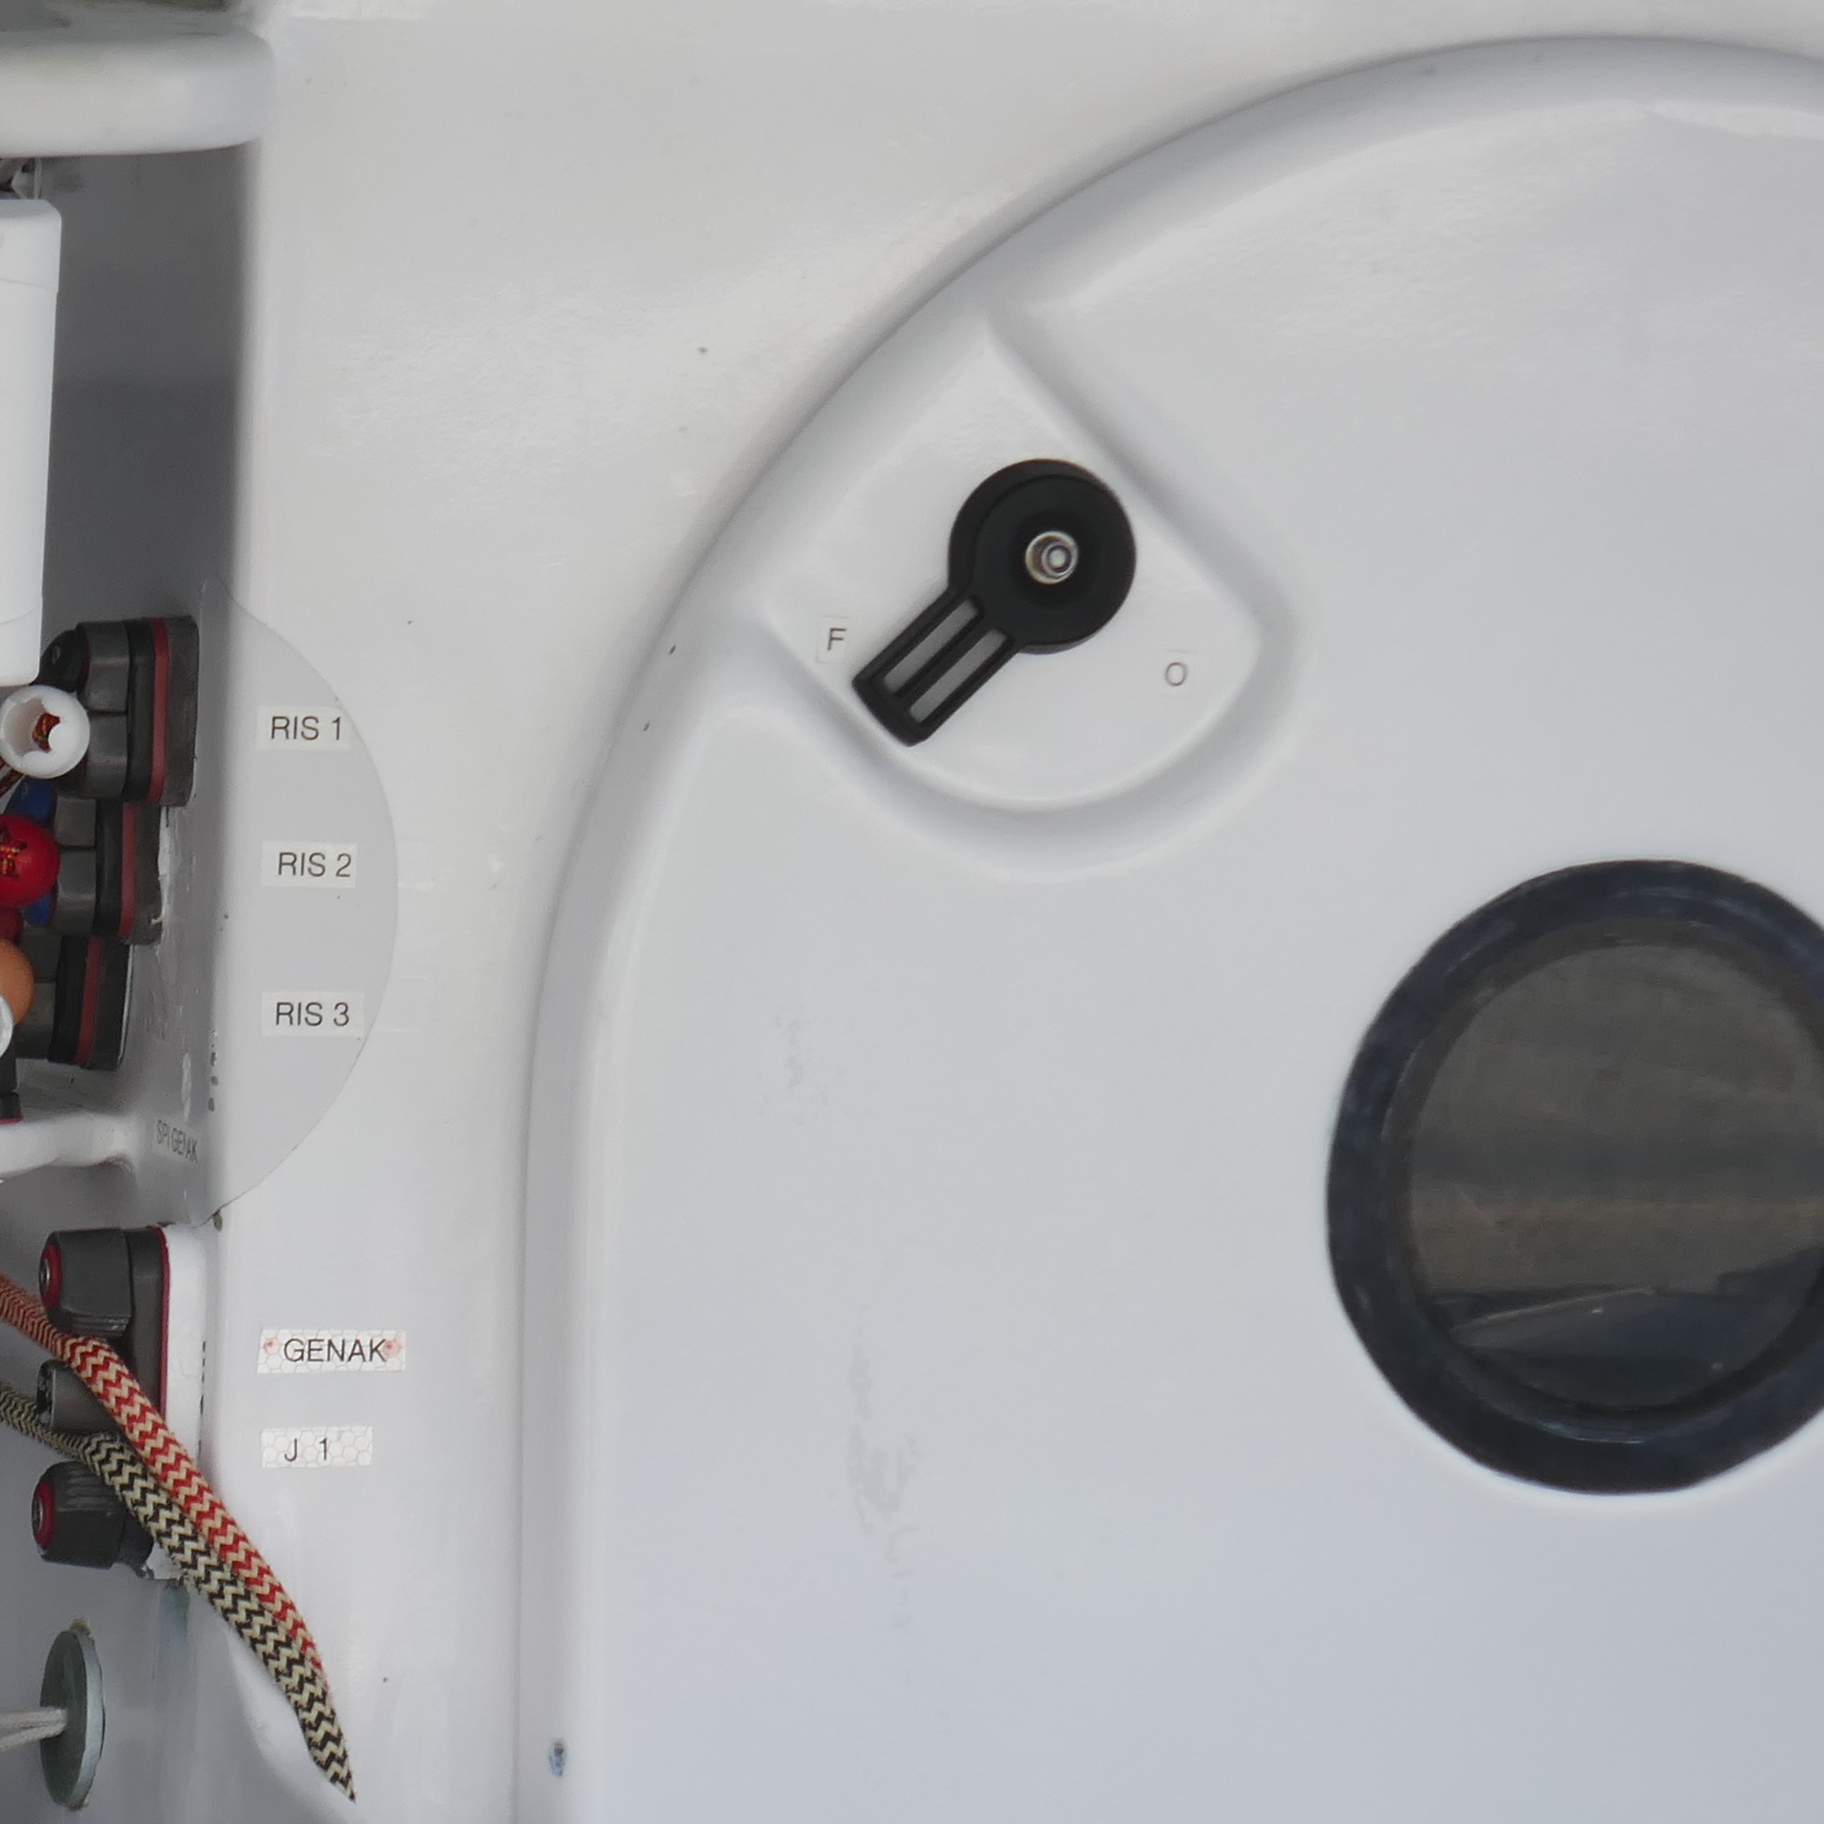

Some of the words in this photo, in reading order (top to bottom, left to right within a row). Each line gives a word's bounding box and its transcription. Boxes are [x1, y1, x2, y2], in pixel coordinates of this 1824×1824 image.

[827, 627, 847, 651] F
[270, 715, 320, 741] RIS
[331, 716, 342, 741] 1
[277, 852, 327, 877] RIS
[335, 852, 352, 877] 2
[275, 1002, 325, 1026] RIS
[332, 1001, 350, 1027] 3
[283, 1338, 387, 1363] GENAK
[284, 1438, 298, 1462] J
[319, 1437, 329, 1461] 1
